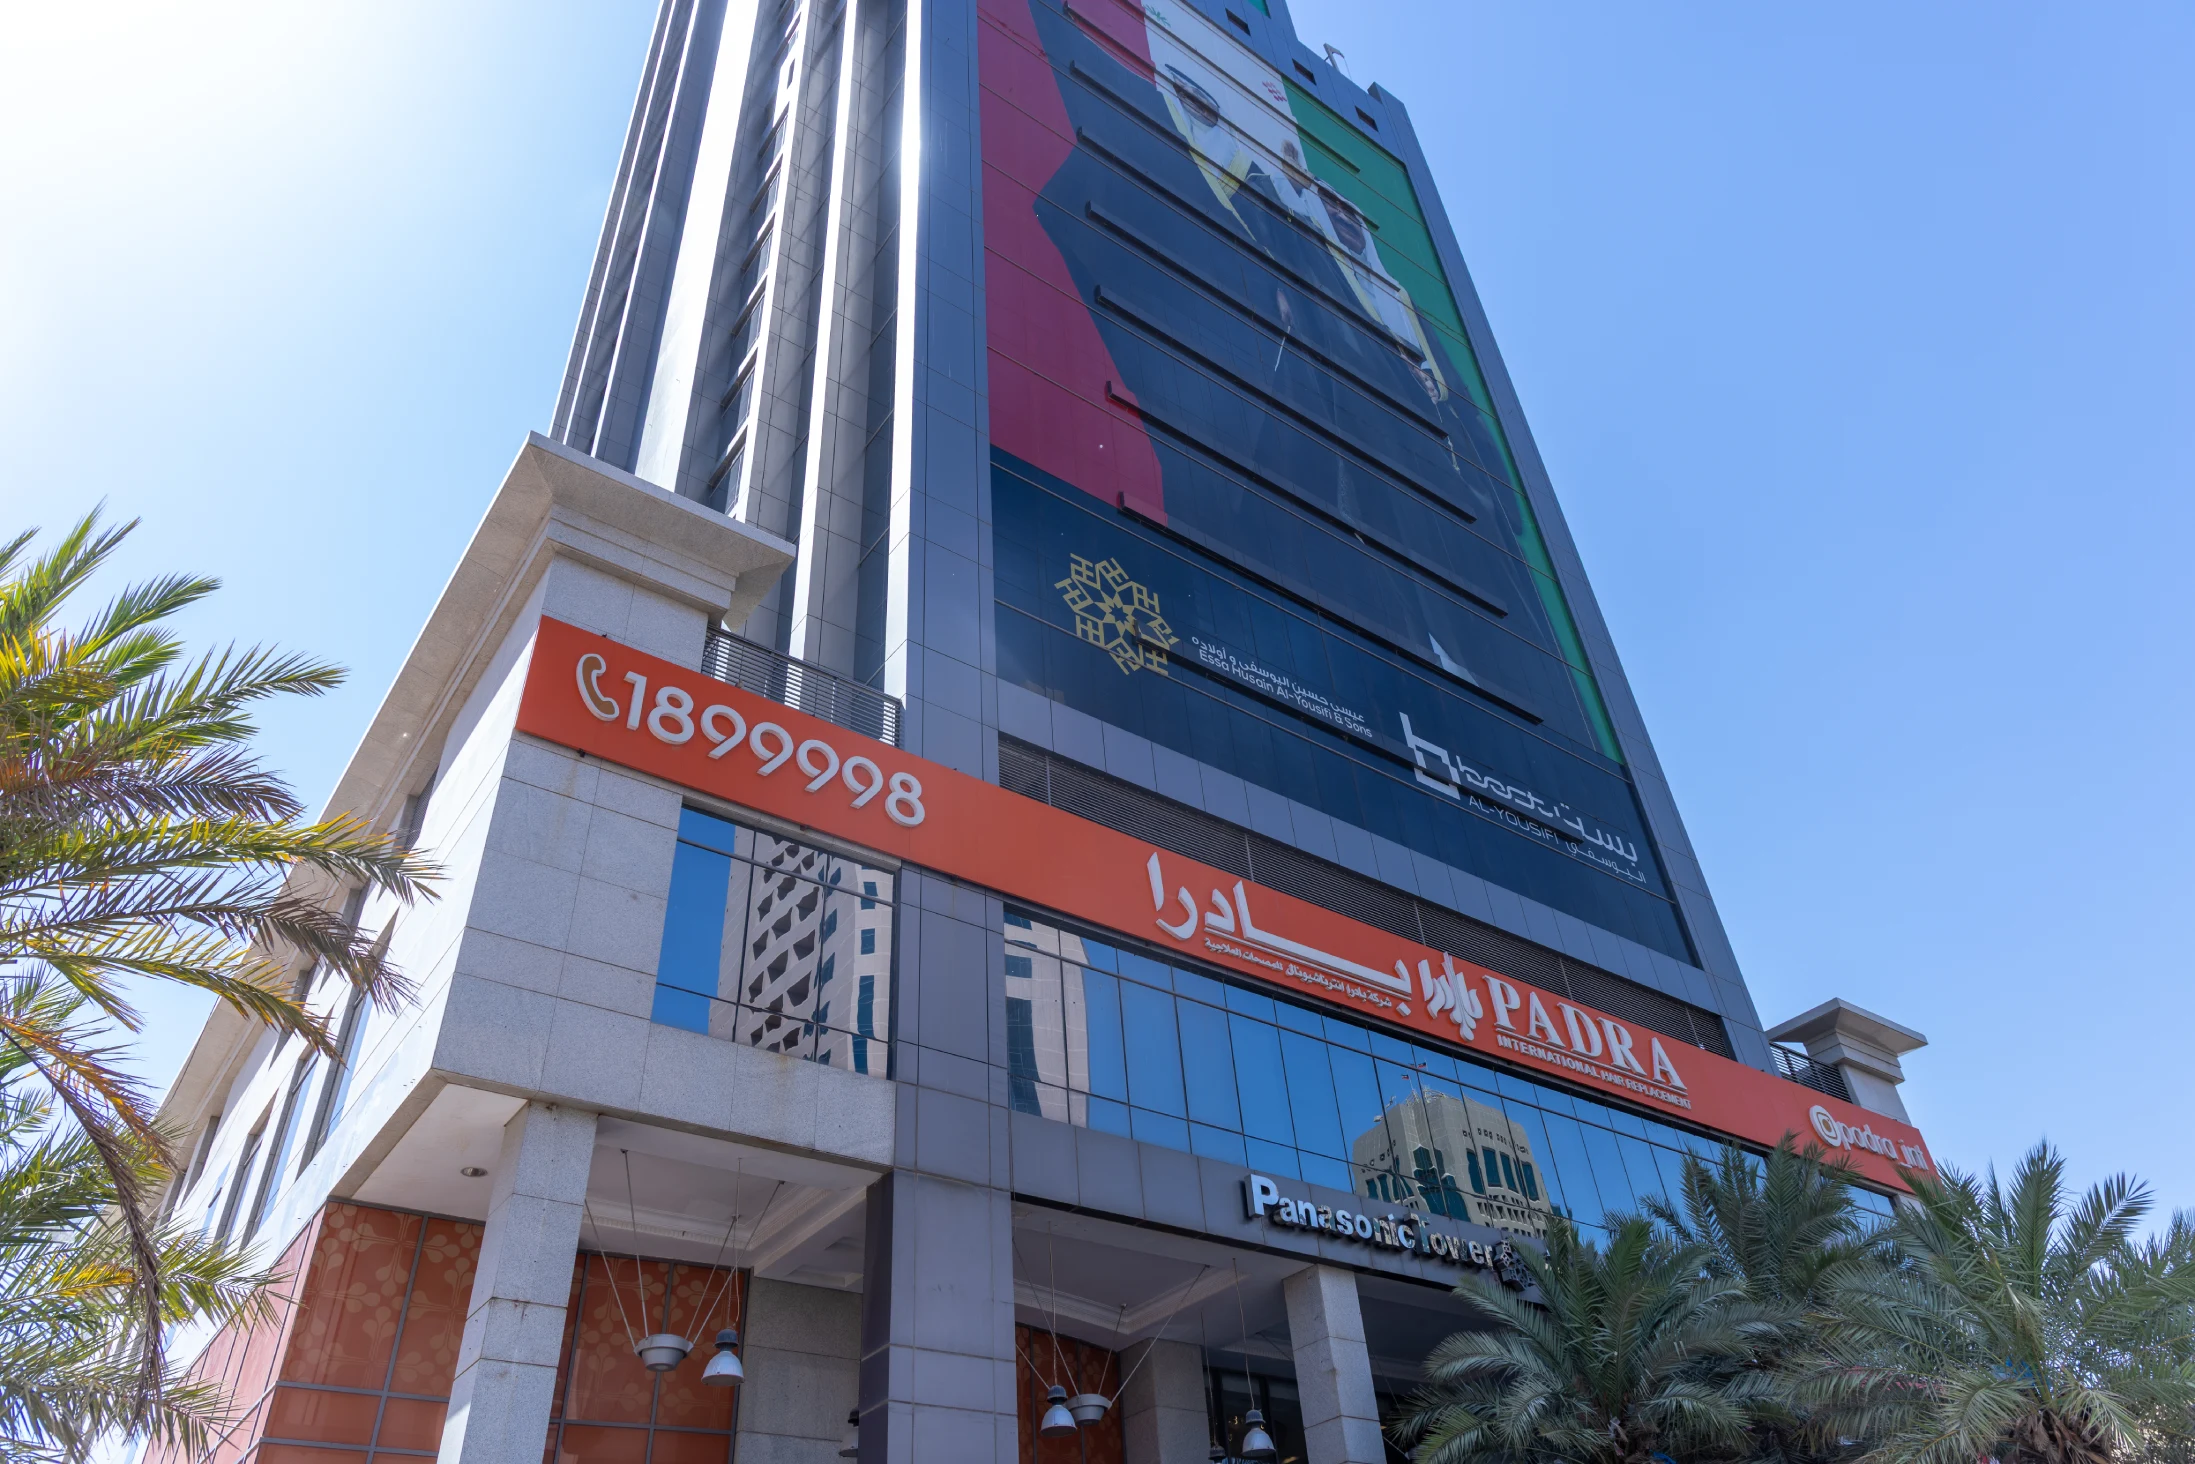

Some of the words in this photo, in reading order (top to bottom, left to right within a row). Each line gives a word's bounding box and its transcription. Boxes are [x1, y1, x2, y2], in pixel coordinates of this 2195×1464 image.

[1199, 648, 1230, 672] Essa
[1232, 664, 1274, 694] Husain
[1276, 685, 1333, 720] Al-Yousifi
[1344, 716, 1373, 738] Sons
[623, 670, 926, 828] 1899998
[1469, 795, 1560, 845] AL-YOUSIFI
[1346, 983, 1367, 1003] بادرا
[1366, 990, 1393, 1008] شركة
[1482, 974, 1687, 1091] PADRA
[1496, 1034, 1601, 1079] INTERNATIONAL
[1600, 1069, 1627, 1087] HAIR
[1625, 1078, 1692, 1110] REPLACEMENT
[1244, 1172, 1416, 1252] Panasonic
[1407, 1211, 1494, 1272] Tower
